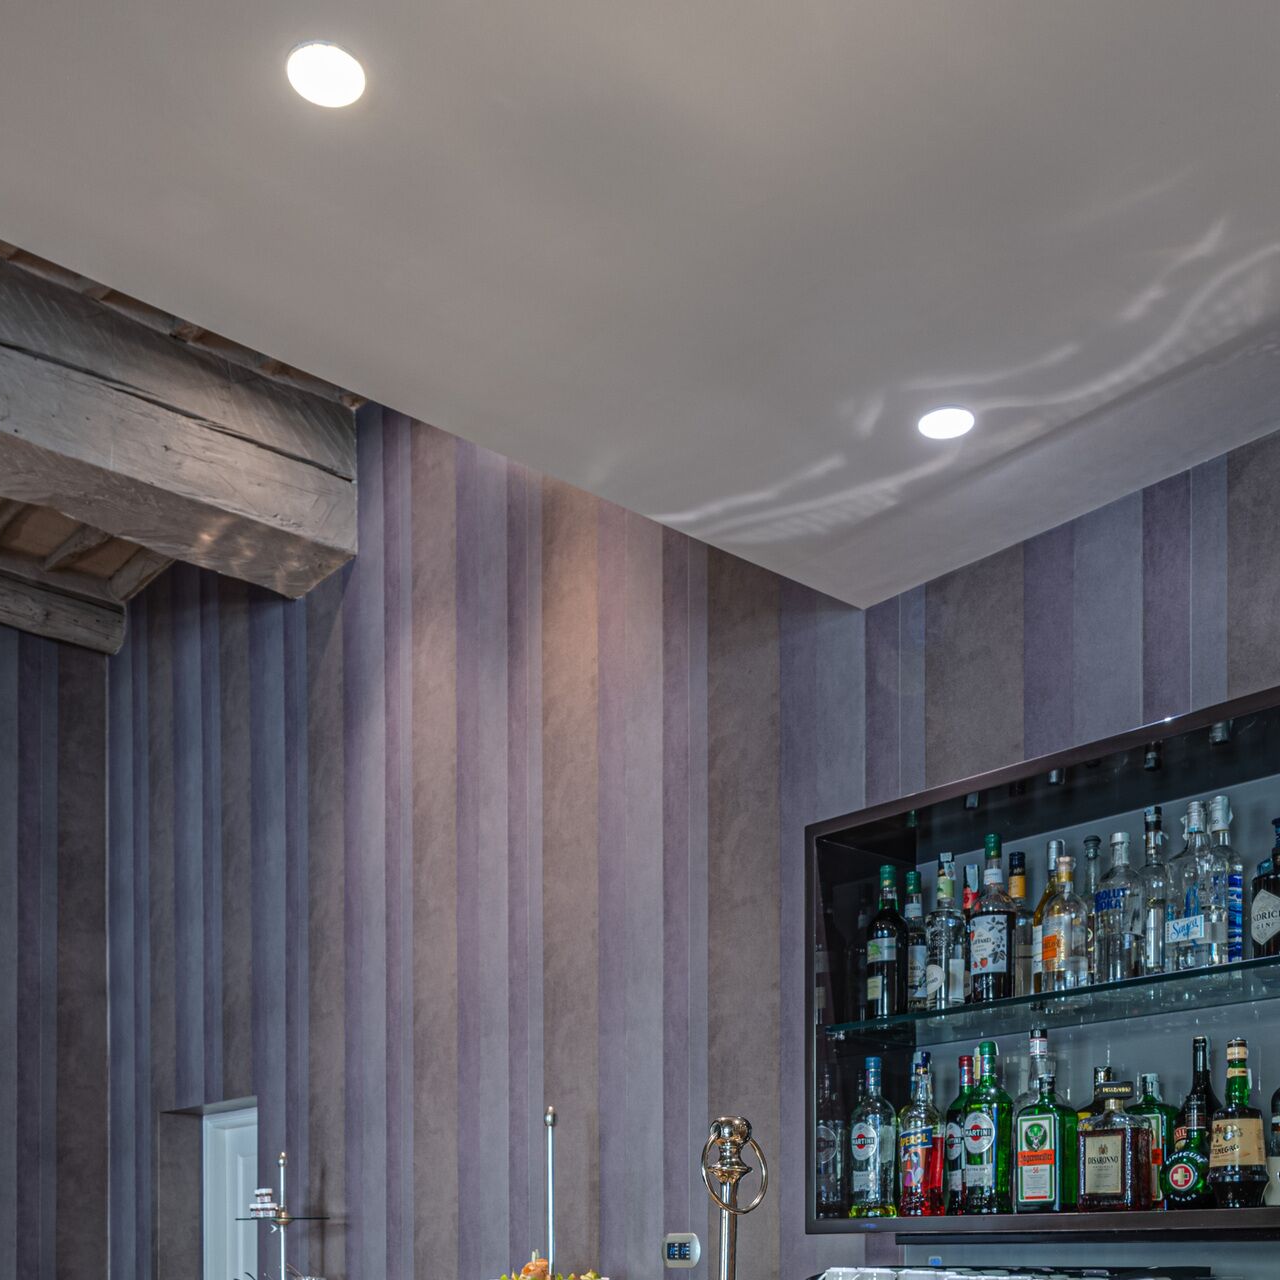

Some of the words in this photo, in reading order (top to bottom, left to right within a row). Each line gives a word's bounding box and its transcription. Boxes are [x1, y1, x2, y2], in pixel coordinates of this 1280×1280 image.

[965, 1128, 992, 1137] MARTINI
[852, 1137, 875, 1145] MARTINI
[1088, 1156, 1119, 1165] DISARONNO
[1165, 1151, 1204, 1165] UNICUM
